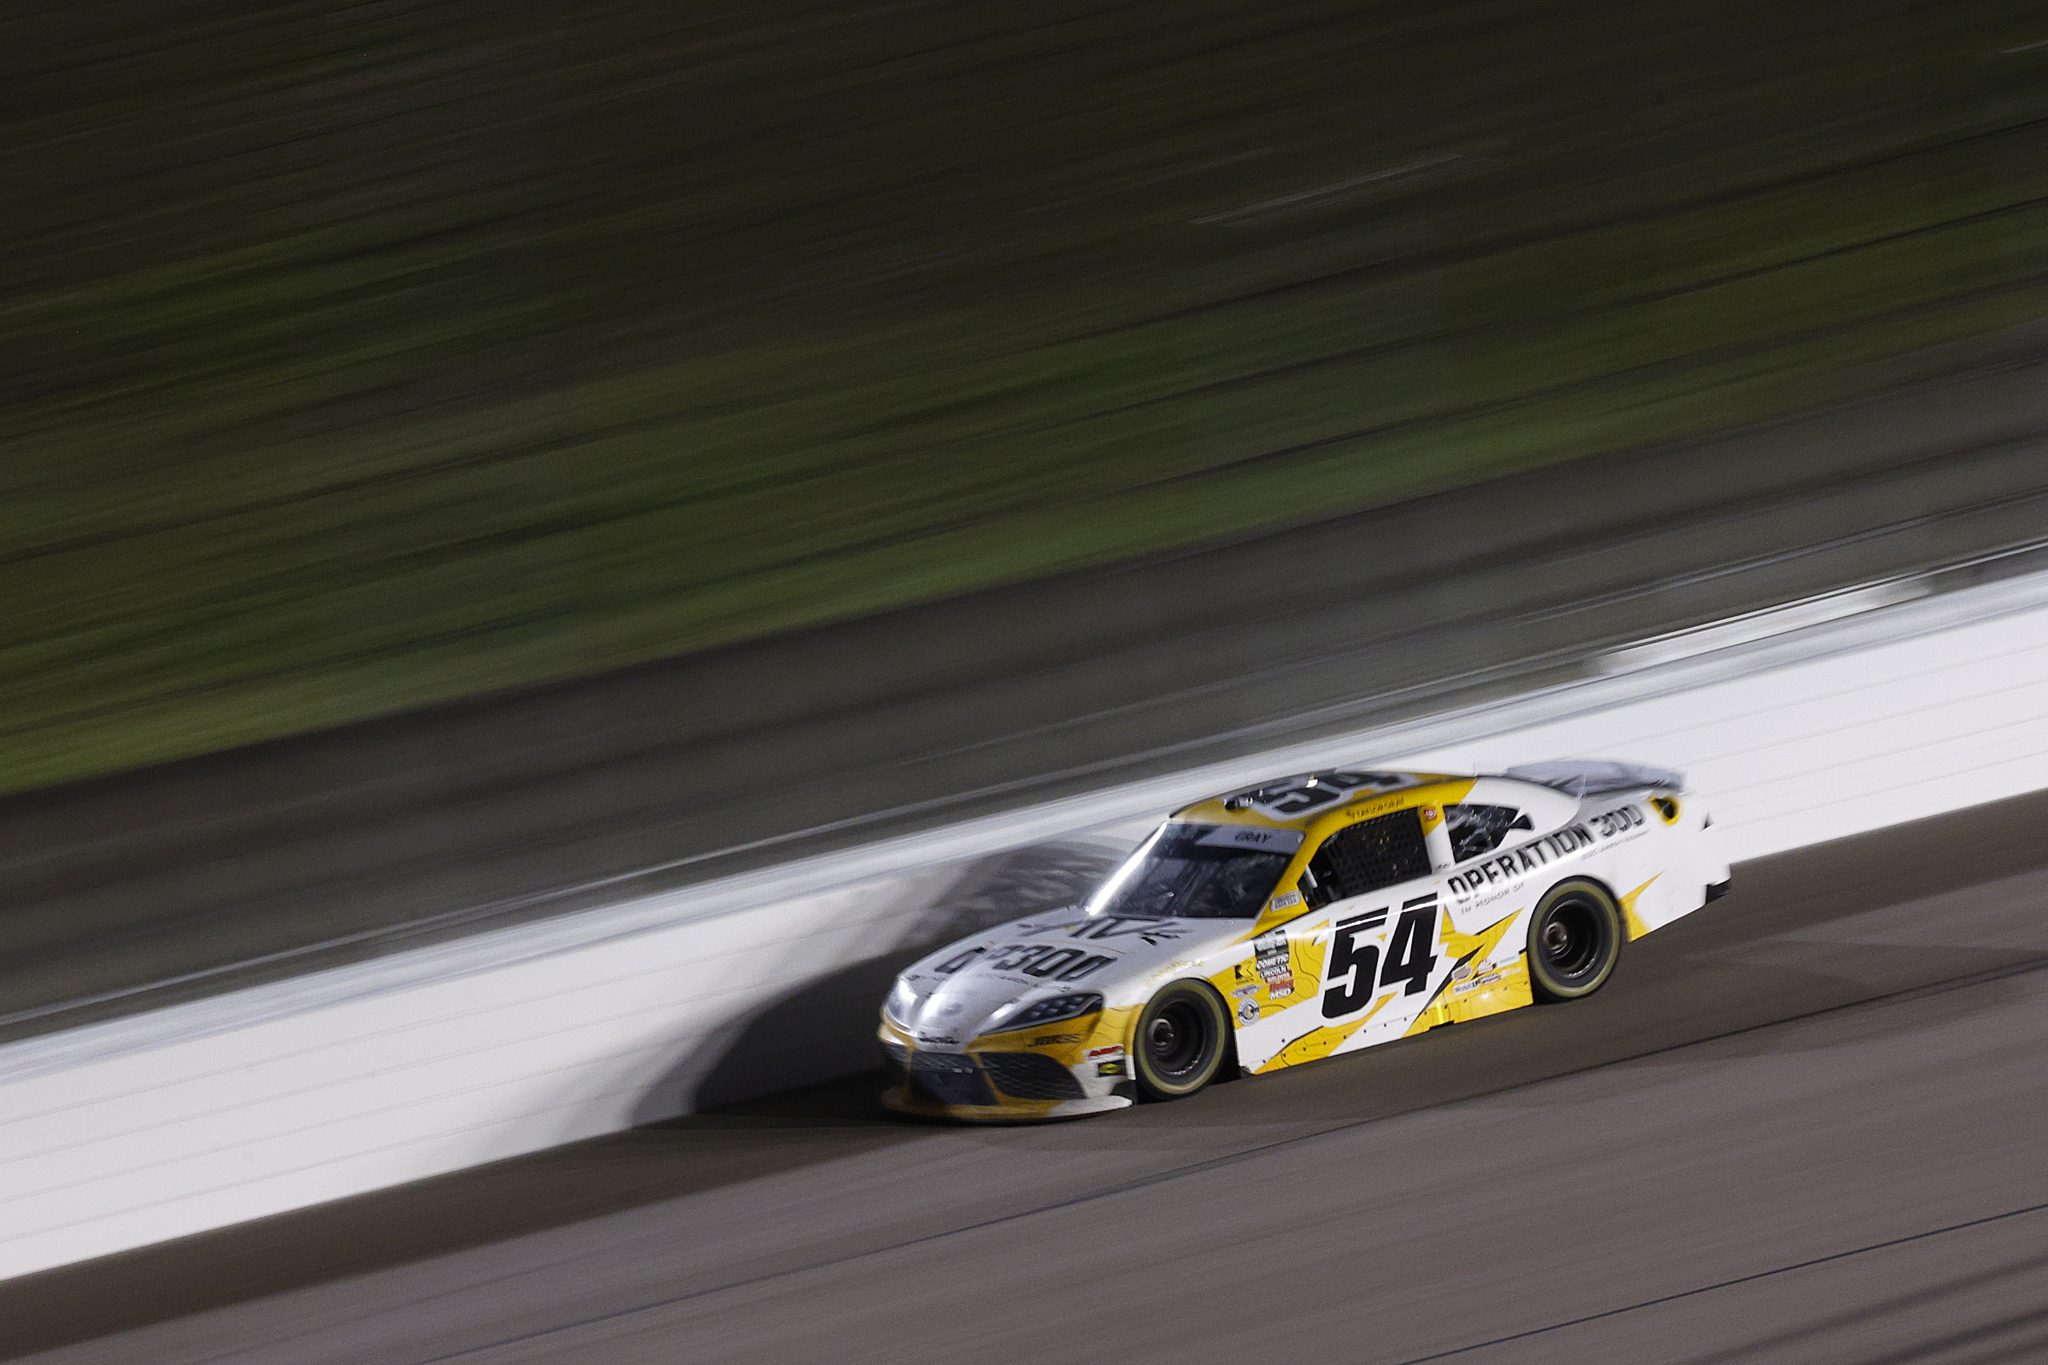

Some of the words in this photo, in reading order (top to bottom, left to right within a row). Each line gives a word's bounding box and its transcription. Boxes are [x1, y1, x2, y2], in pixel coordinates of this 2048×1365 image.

[1447, 822, 1596, 904] OPERATION
[1588, 804, 1646, 838] 300
[1256, 953, 1289, 969] COMETIC
[1321, 892, 1439, 1019] 54
